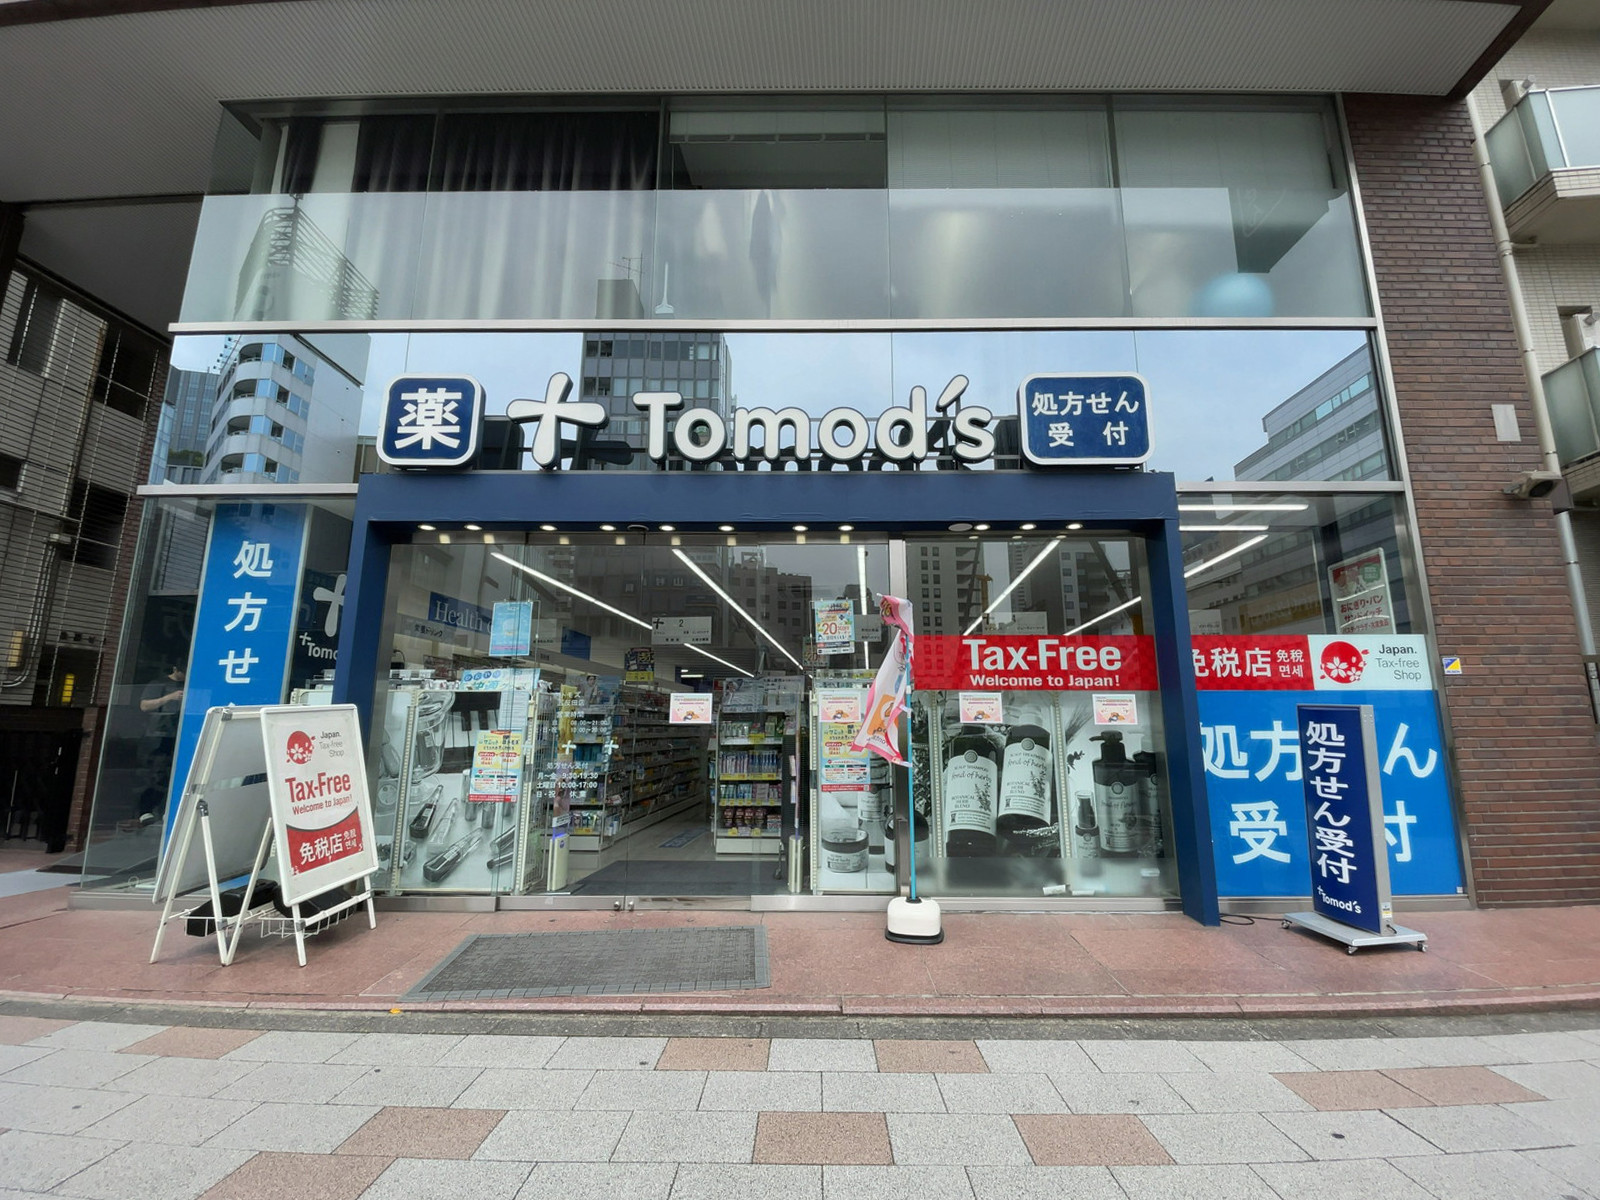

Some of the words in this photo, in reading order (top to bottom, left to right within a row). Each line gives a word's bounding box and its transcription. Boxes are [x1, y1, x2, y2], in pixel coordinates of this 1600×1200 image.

[1031, 391, 1140, 416] 処方せん
[394, 387, 462, 450] 薬
[633, 374, 996, 464] Tomod's
[218, 540, 274, 704] 処方せ
[435, 600, 483, 632] Health
[822, 622, 837, 635] 20
[962, 639, 1121, 671] Tax-Free
[1379, 644, 1417, 656] Japan.
[1279, 664, 1304, 678] 면세
[1375, 658, 1420, 668] Tax-free
[1393, 669, 1422, 682] Shop
[970, 675, 1042, 687] Welcome
[1047, 675, 1063, 687] to
[1068, 675, 1120, 689] Japan!
[329, 749, 344, 758] Shop
[1200, 720, 1437, 783] 処方ん
[285, 772, 351, 803] Tax-Free
[292, 801, 324, 816] Welcome
[325, 799, 332, 808] to
[1306, 721, 1357, 884] 処方せん受付
[300, 833, 344, 865] 免税店
[1321, 892, 1362, 914] Tomod's
